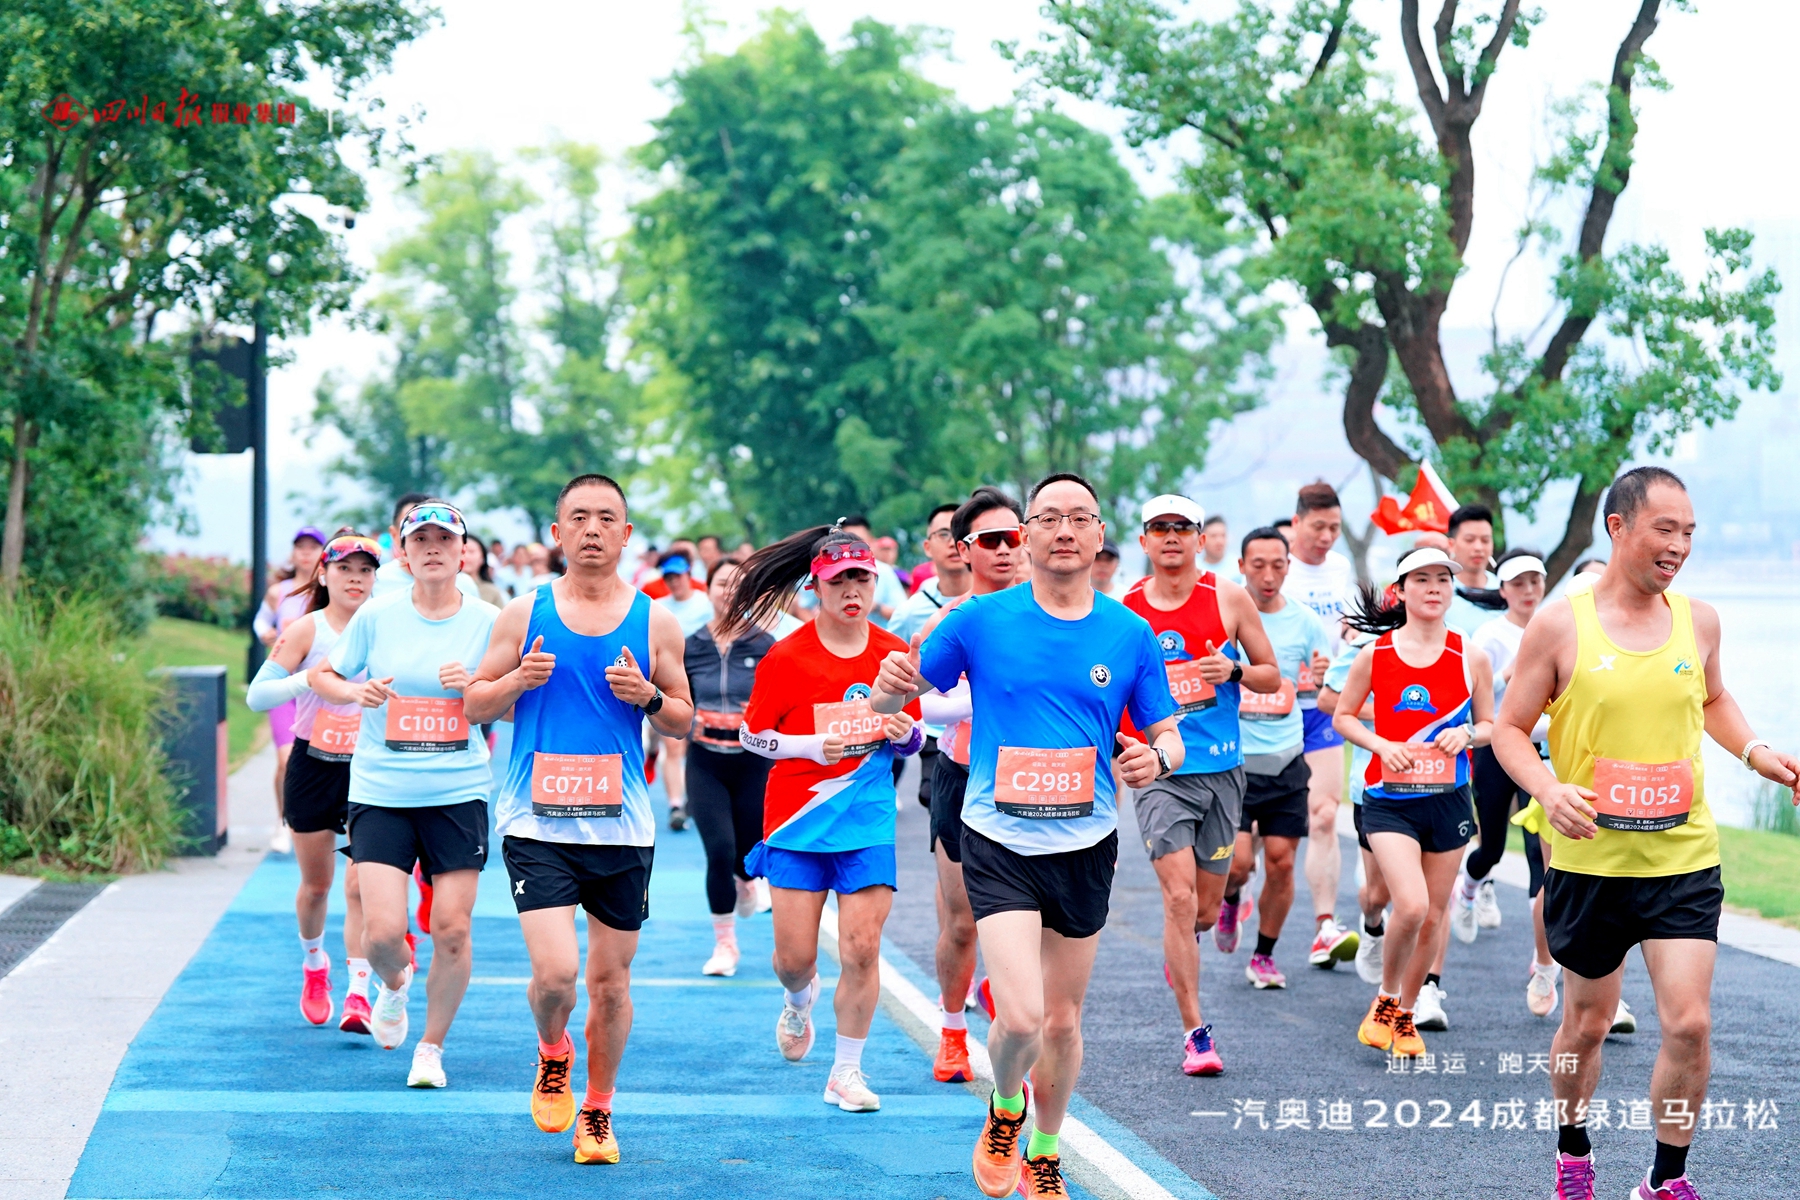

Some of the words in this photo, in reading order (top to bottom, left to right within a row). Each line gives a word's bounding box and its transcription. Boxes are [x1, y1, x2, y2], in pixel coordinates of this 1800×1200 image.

[1170, 678, 1202, 697] 303
[1240, 690, 1287, 706] C2142
[399, 715, 459, 732] C1010
[828, 715, 882, 737] C0509
[322, 729, 359, 746] C170
[1404, 759, 1446, 775] 039
[542, 775, 609, 794] C0714
[1012, 771, 1082, 792] C2983
[1609, 784, 1680, 806] C1052
